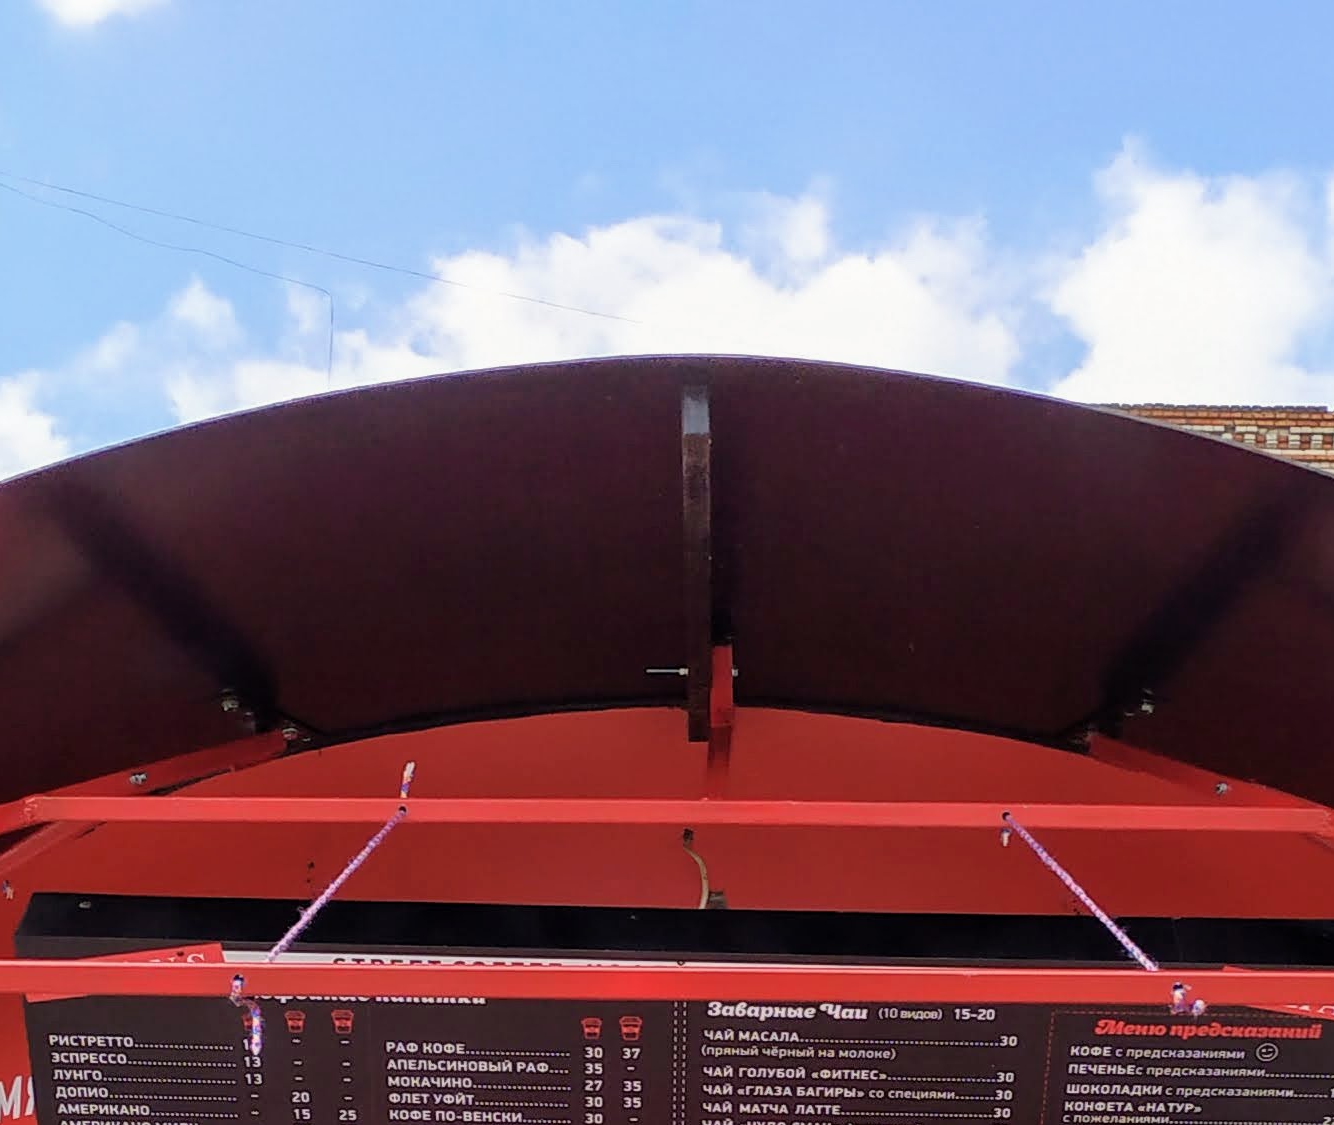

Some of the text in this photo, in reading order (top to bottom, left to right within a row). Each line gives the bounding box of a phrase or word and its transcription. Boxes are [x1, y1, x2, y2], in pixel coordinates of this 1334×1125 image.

[707, 1001, 817, 1022] Заварные
[877, 1007, 899, 1019] (10
[899, 1008, 943, 1020] видов)
[954, 1008, 996, 1021] 15-20
[1095, 1018, 1322, 1040] Меню предсказаний
[48, 1034, 133, 1048] РИСТРЕТТО
[703, 1028, 1018, 1047] ЧАЙ МАСАЛА 30
[385, 1041, 641, 1060] РАФ КОФЕ 30 37
[701, 1044, 897, 1060] (пряный чёрный на молоке)
[1069, 1046, 1245, 1060] КОФЕ с предсказаниями
[243, 1056, 261, 1068] 13
[387, 1058, 603, 1074] АПЕЛЬСИНОВЫЙ РАФ 35
[53, 1068, 263, 1085] ЛУНГО 13
[703, 1065, 733, 1078] ЧАЙ
[738, 1066, 805, 1079] ГОЛУБОЙ
[997, 1072, 1015, 1083] 30
[1146, 1066, 1265, 1078] предсказаниями
[387, 1076, 641, 1092] МОКАЧИНО 27 35
[703, 1083, 733, 1096] ЧАЙ
[869, 1090, 885, 1098] со
[887, 1090, 955, 1101] специями
[995, 1090, 1013, 1100] 30
[1065, 1084, 1163, 1096] ШОКОЛАДКИ
[1165, 1086, 1173, 1095] с
[1175, 1086, 1294, 1098] предсказаниями
[55, 1086, 311, 1103] ДОПИО 20
[389, 1092, 429, 1104] ФЛЕТ
[585, 1096, 603, 1108] 30
[623, 1097, 641, 1108] 35
[57, 1103, 357, 1121] АМЕРИКАНО 15 25
[702, 1100, 1011, 1118] ЧАЙ МАТЧА ЛАТТЕ 30
[1064, 1101, 1133, 1112] КОНФЕТА
[389, 1109, 603, 1124] КОФЕ ПО-ВЕНСКИ 30
[1063, 1114, 1070, 1122] с
[1073, 1114, 1169, 1124] пожеланиями
